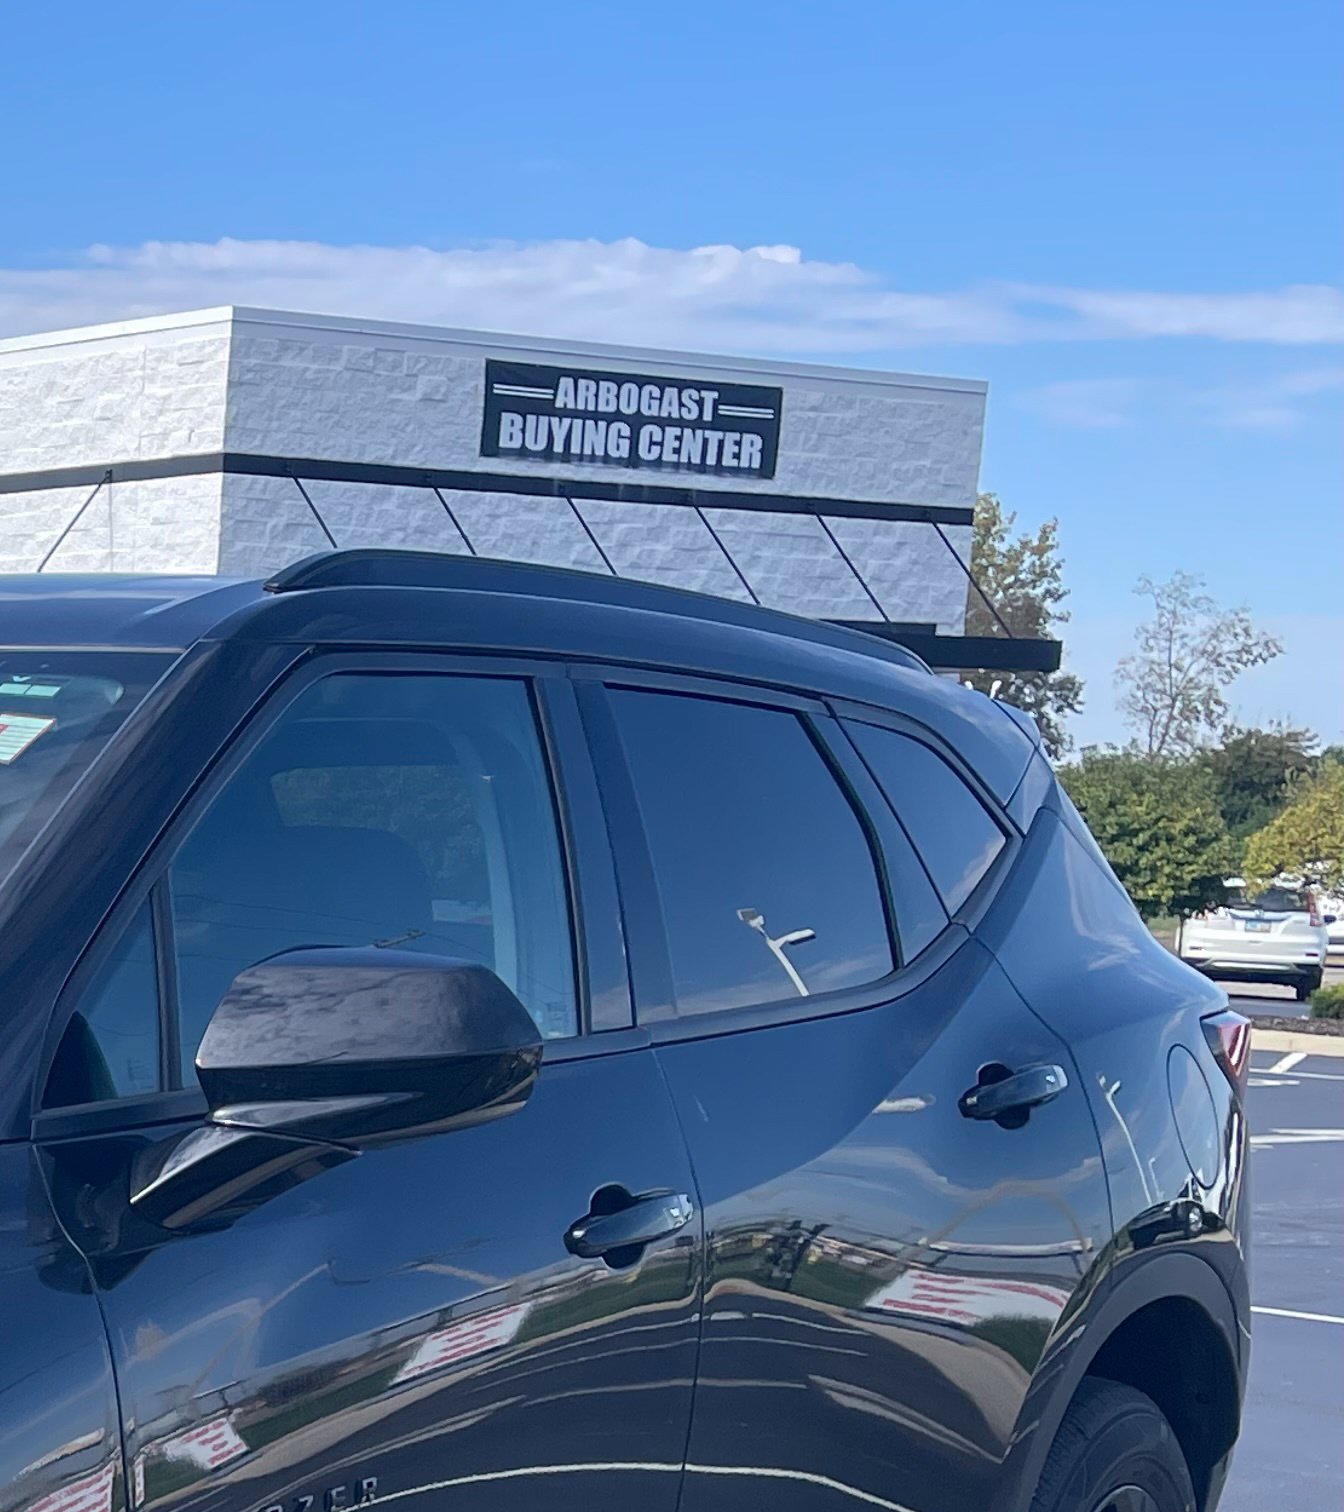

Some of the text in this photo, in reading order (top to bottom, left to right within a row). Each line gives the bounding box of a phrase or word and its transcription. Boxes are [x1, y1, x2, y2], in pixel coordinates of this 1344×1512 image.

[554, 376, 719, 421] ARBOGAST
[499, 412, 764, 469] BUYING CENTER
